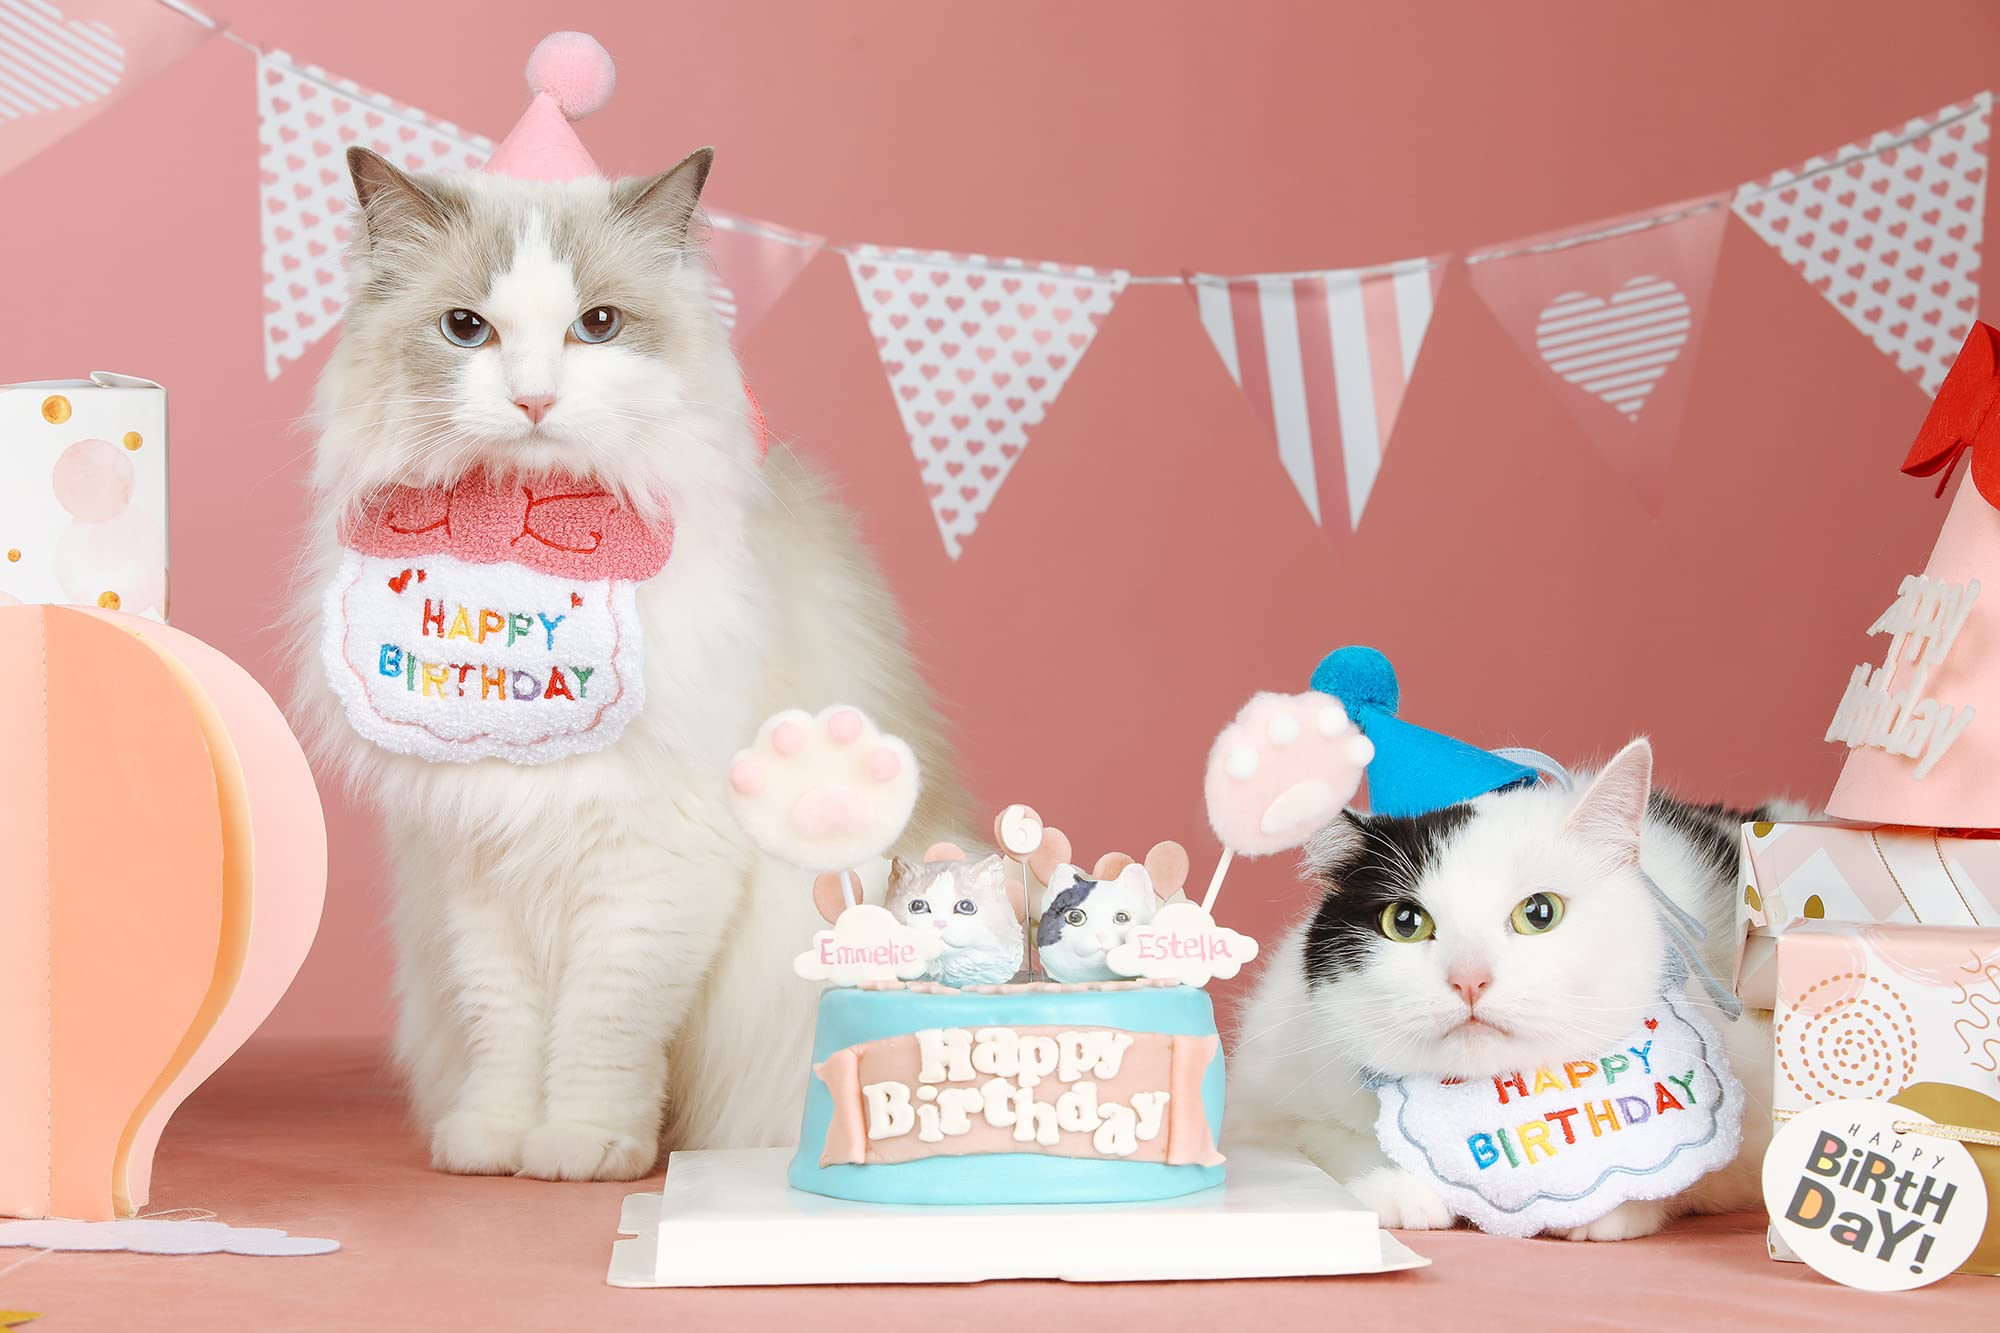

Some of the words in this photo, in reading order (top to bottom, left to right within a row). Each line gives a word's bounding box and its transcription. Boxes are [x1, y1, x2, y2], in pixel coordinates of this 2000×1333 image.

[422, 598, 566, 650] HAPPY
[378, 643, 595, 701] BIRTHDAY
[1000, 804, 1043, 854] 6
[1137, 931, 1233, 962] Estella
[915, 1027, 1134, 1088] Happy
[1491, 1039, 1653, 1105] HAPPY
[863, 1077, 1171, 1156] Birthday
[1466, 1069, 1697, 1171] BIRTHDAY
[1848, 1122, 1945, 1170] HAPPY
